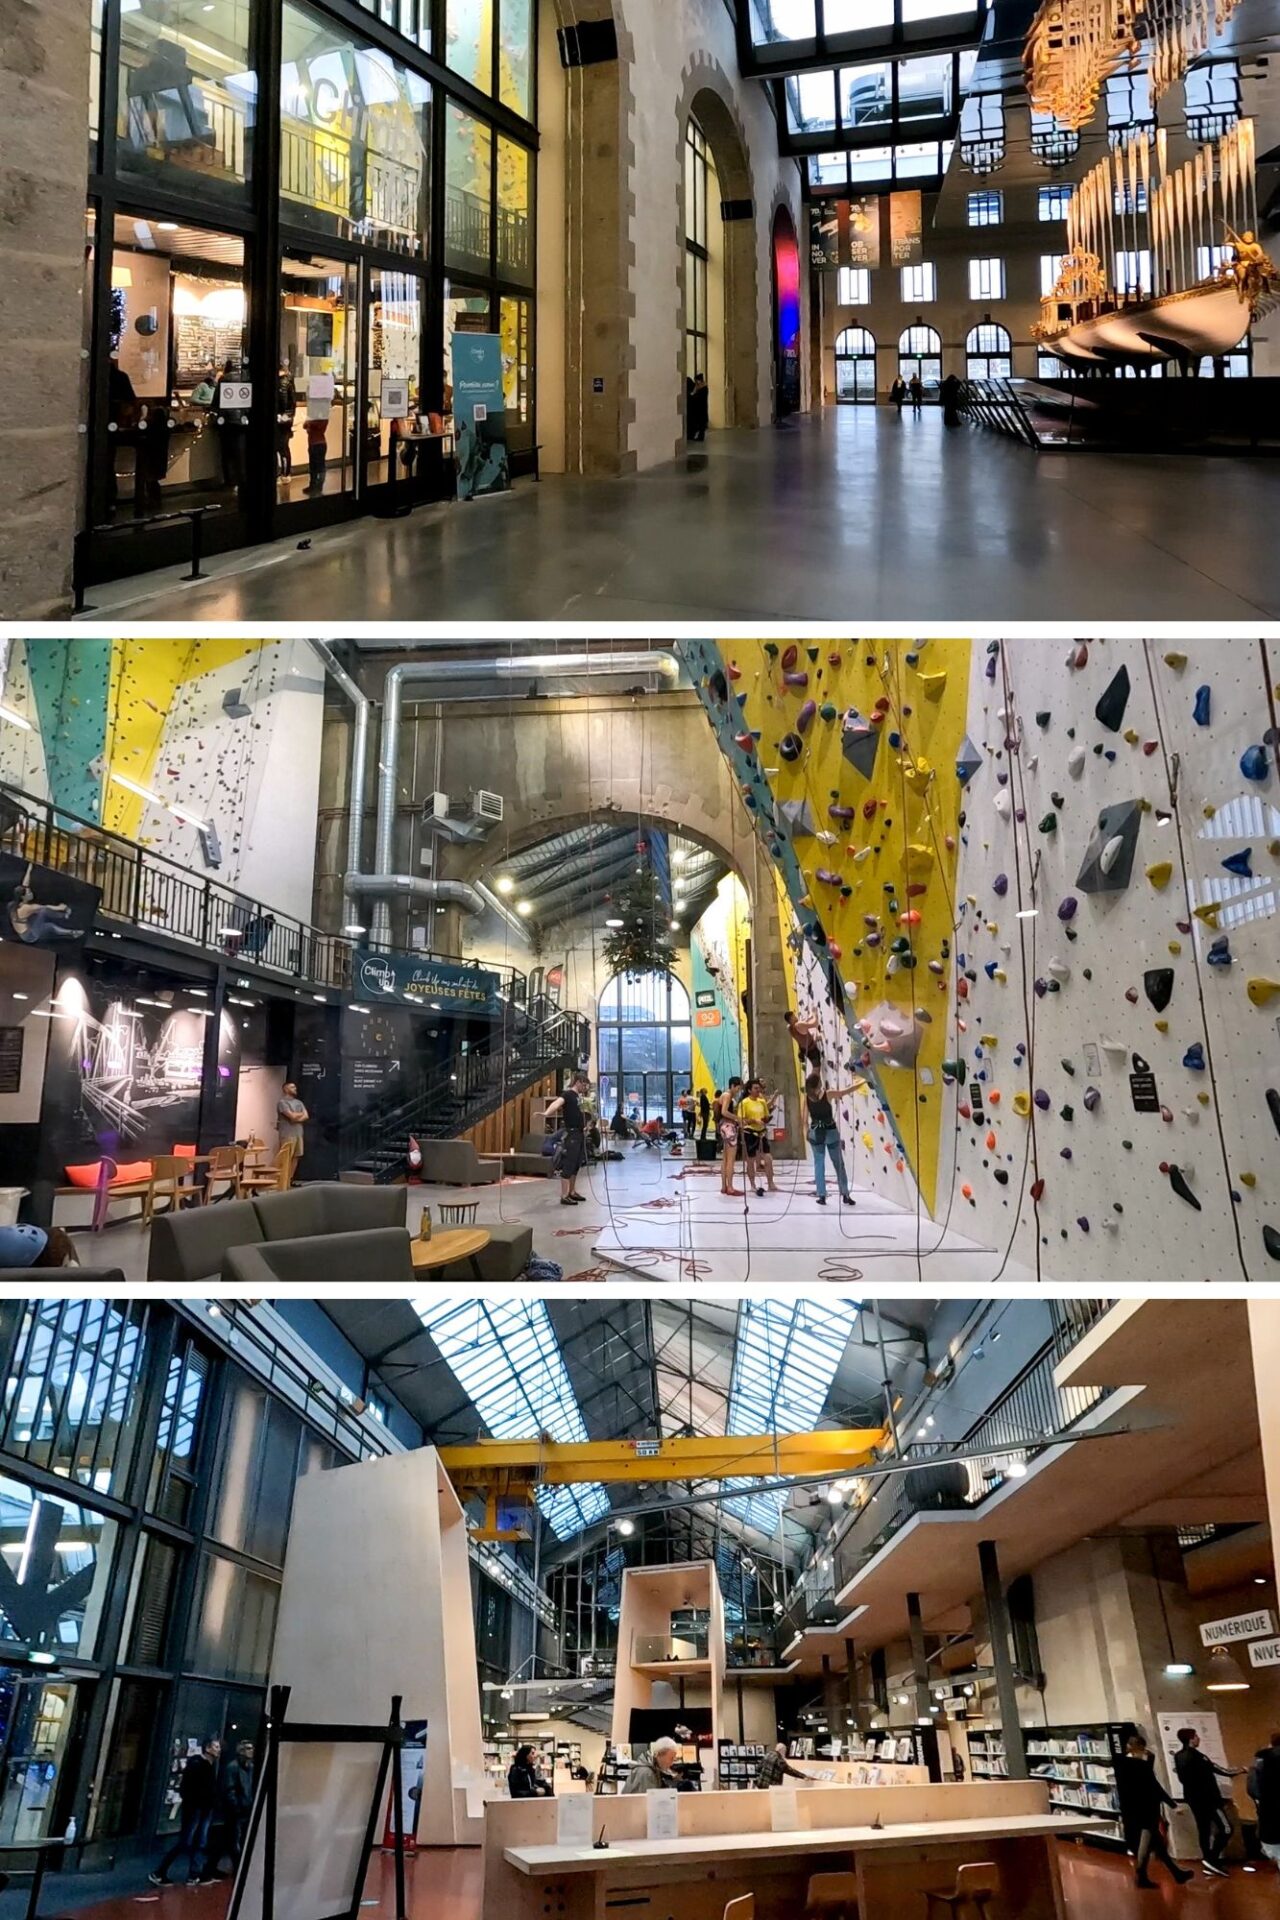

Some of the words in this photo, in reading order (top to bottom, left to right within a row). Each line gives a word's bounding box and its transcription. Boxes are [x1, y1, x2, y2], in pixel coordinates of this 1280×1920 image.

[811, 243, 820, 251] IN
[811, 250, 824, 258] NO
[851, 254, 868, 262] VER
[811, 256, 827, 265] VER
[404, 983, 456, 998] JOYEUSES
[458, 988, 486, 1001] FÊTES
[1204, 1616, 1267, 1640] NUMÉRIQUE
